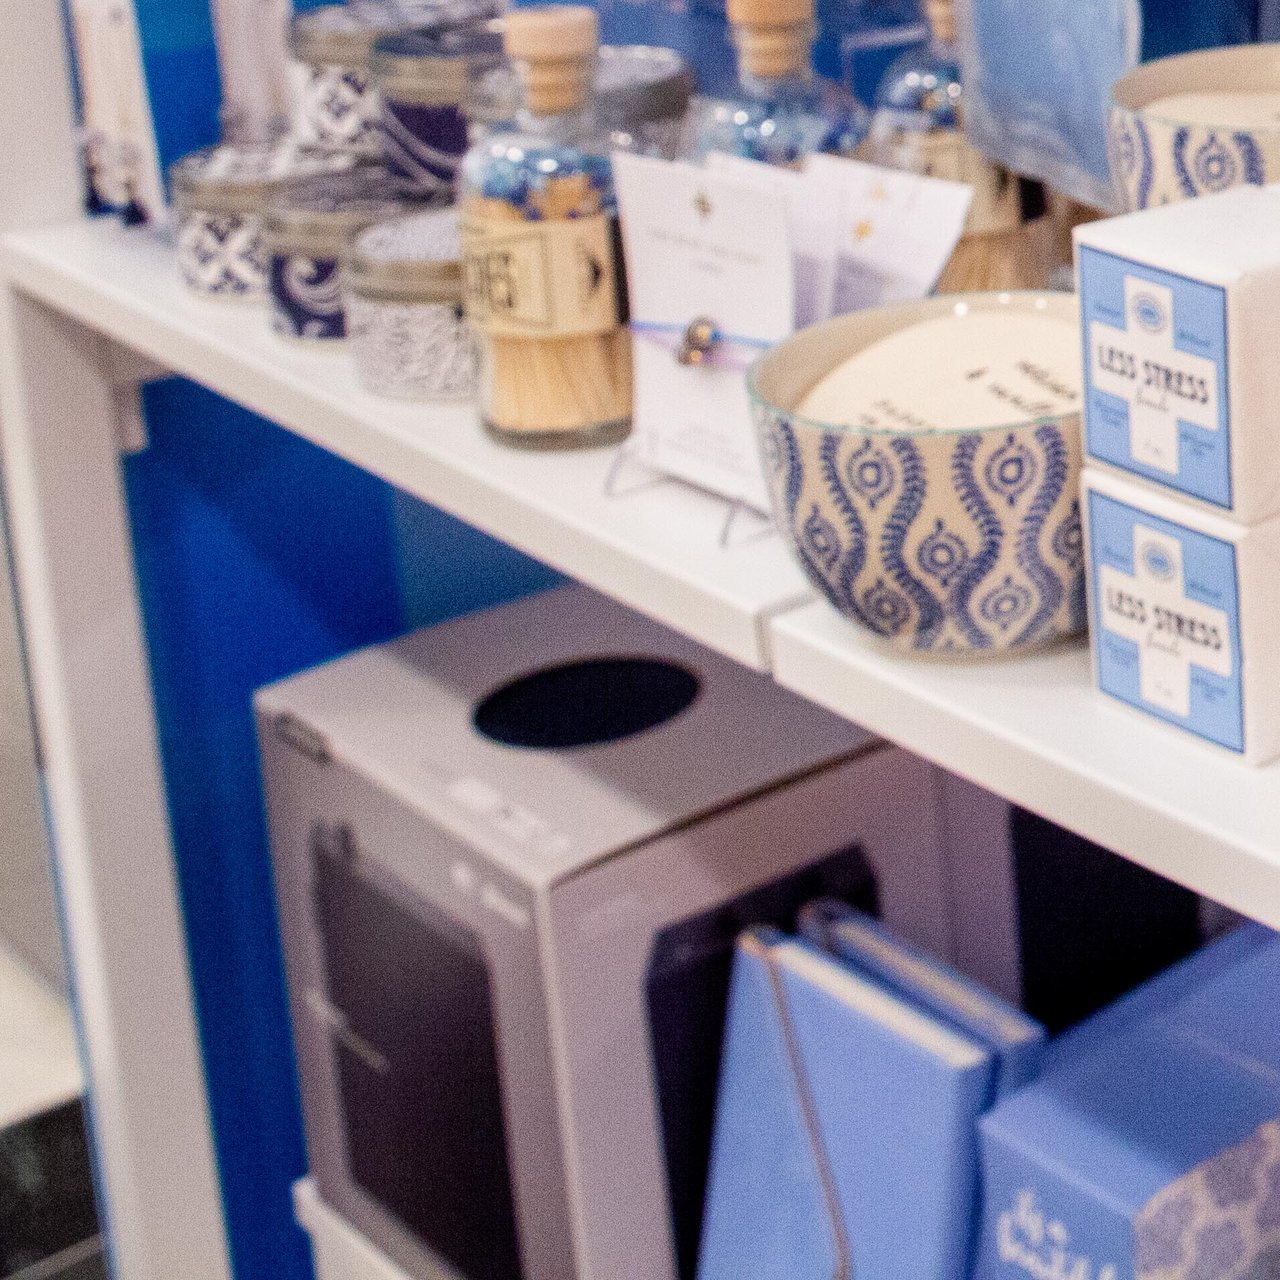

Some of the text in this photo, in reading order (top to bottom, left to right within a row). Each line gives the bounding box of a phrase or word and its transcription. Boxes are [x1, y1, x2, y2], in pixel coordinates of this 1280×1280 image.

[1098, 344, 1137, 381] LESS
[1142, 358, 1209, 406] STRESS
[1107, 587, 1148, 624] LESS
[1152, 604, 1222, 652] STRESS
